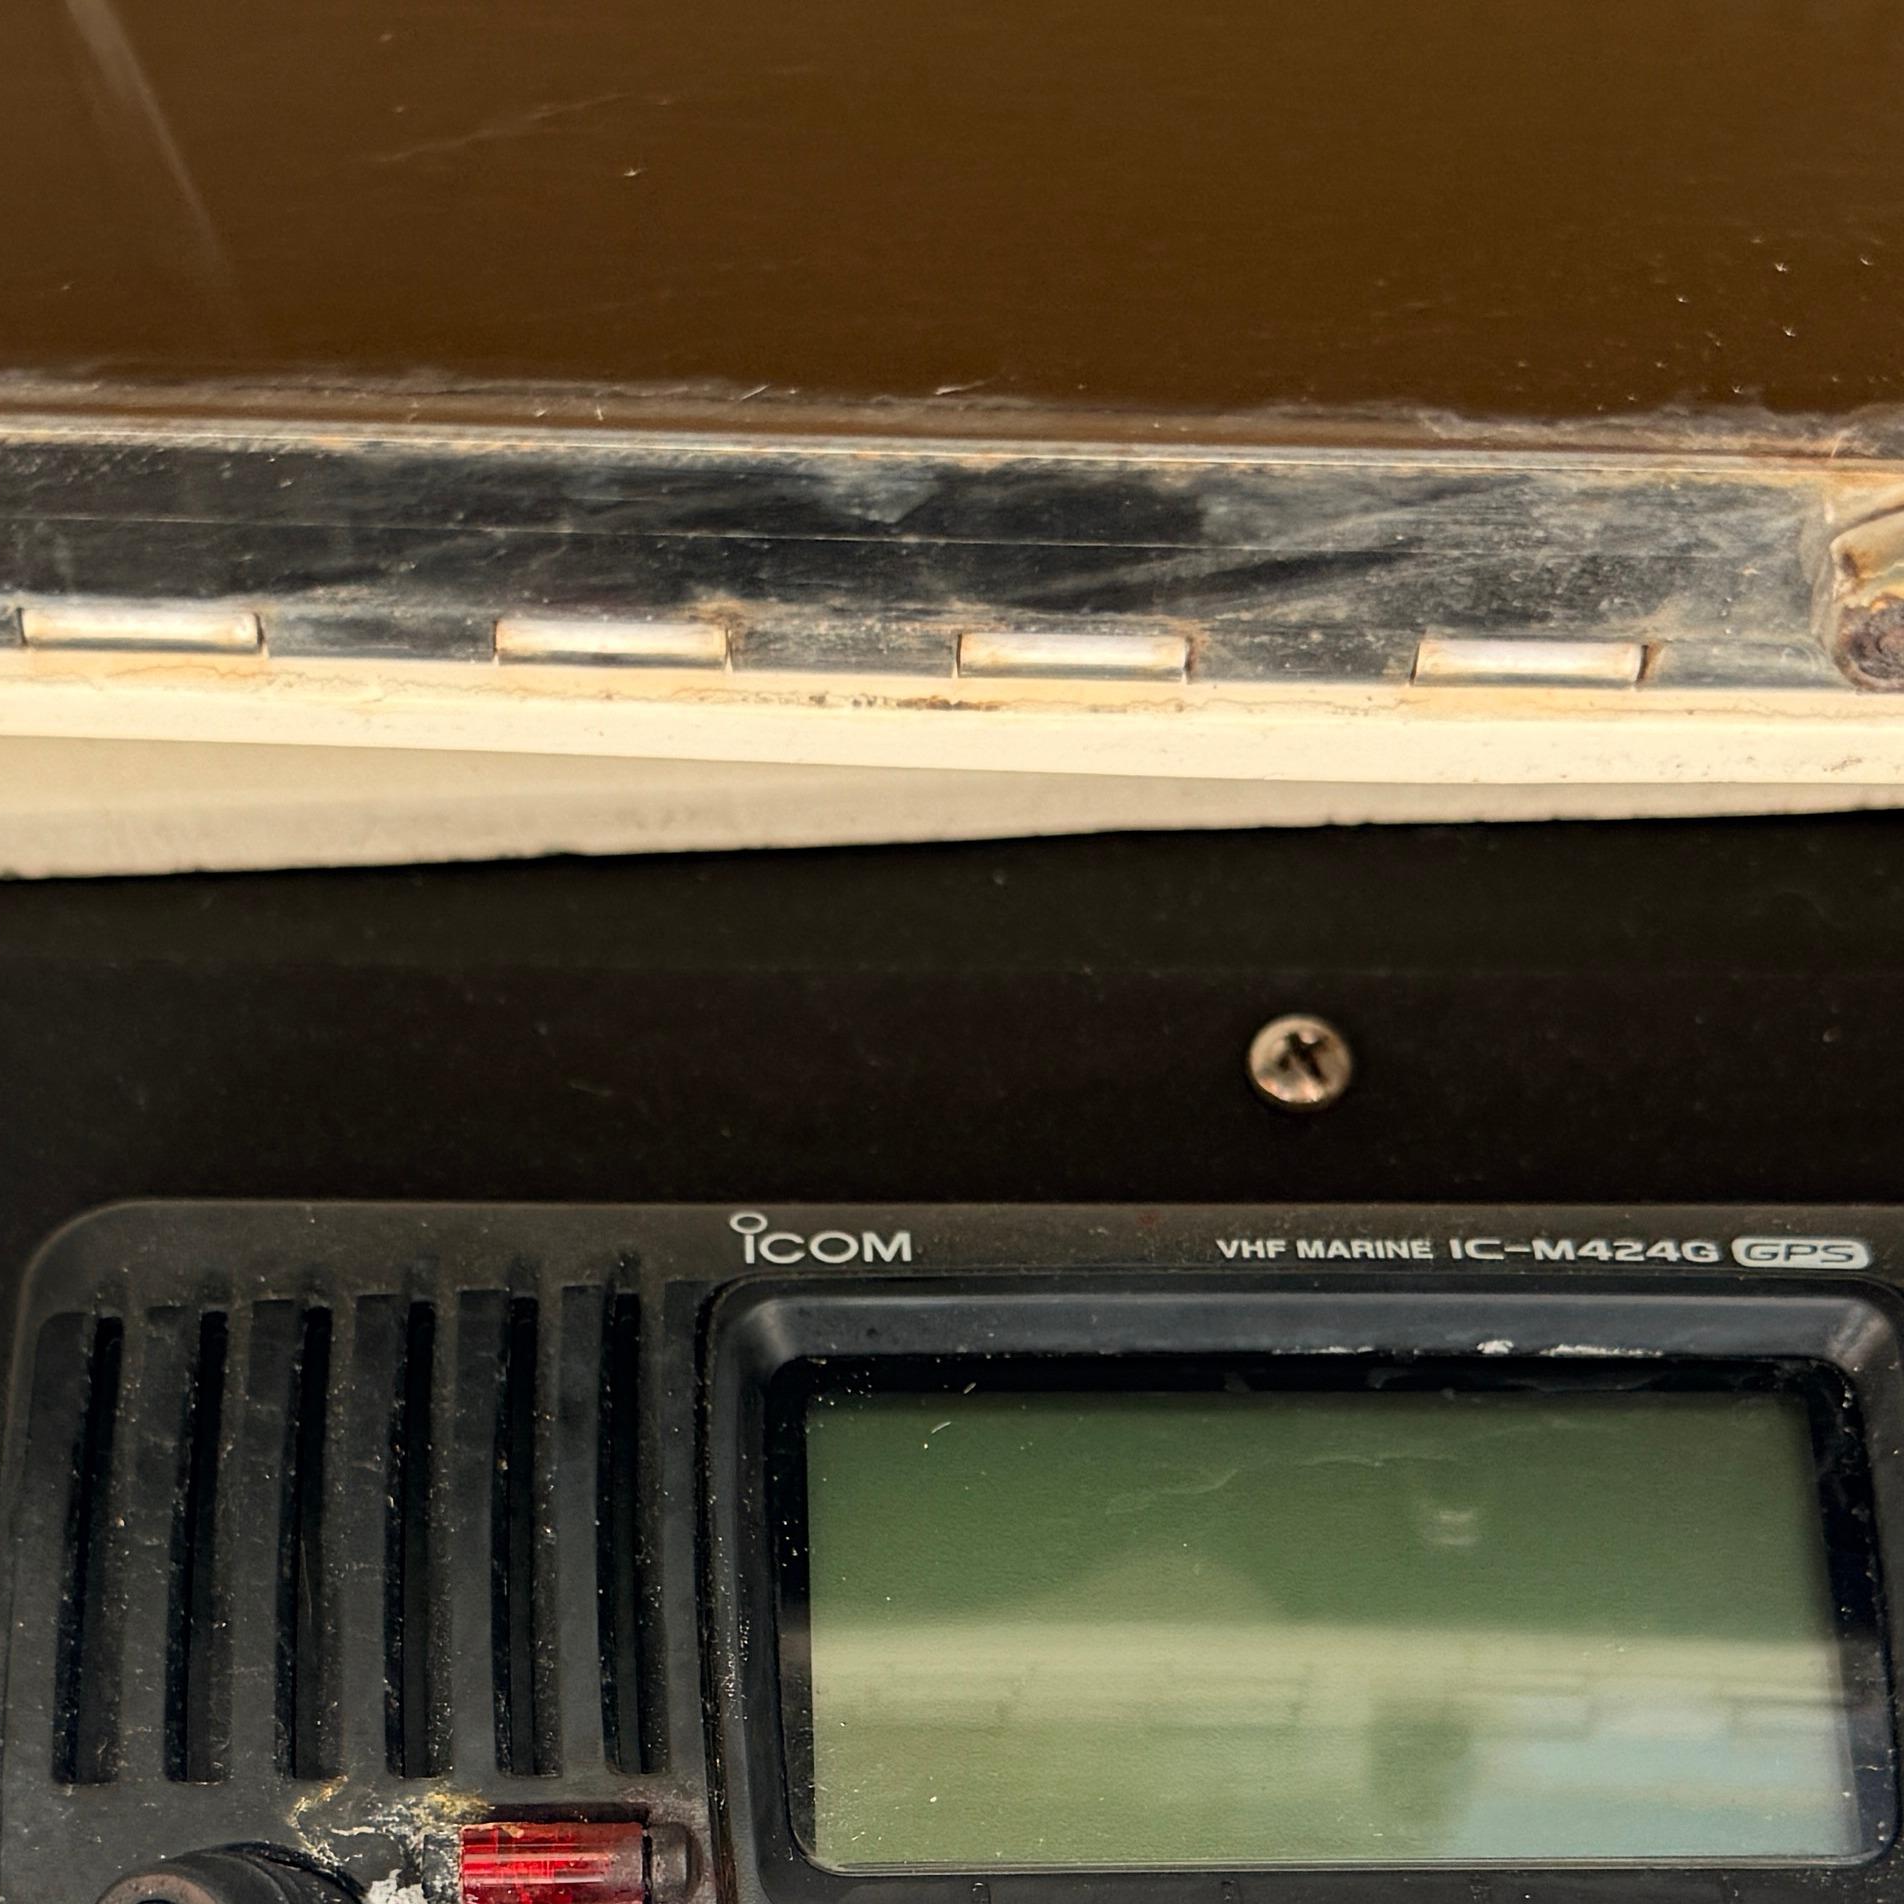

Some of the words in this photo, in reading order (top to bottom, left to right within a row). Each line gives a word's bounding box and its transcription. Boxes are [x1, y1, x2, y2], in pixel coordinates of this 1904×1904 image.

[1216, 1239, 1286, 1260] VHF
[1296, 1239, 1433, 1260] MARINE
[1449, 1239, 1721, 1263] IC-M424G
[1745, 1242, 1857, 1264] GPS
